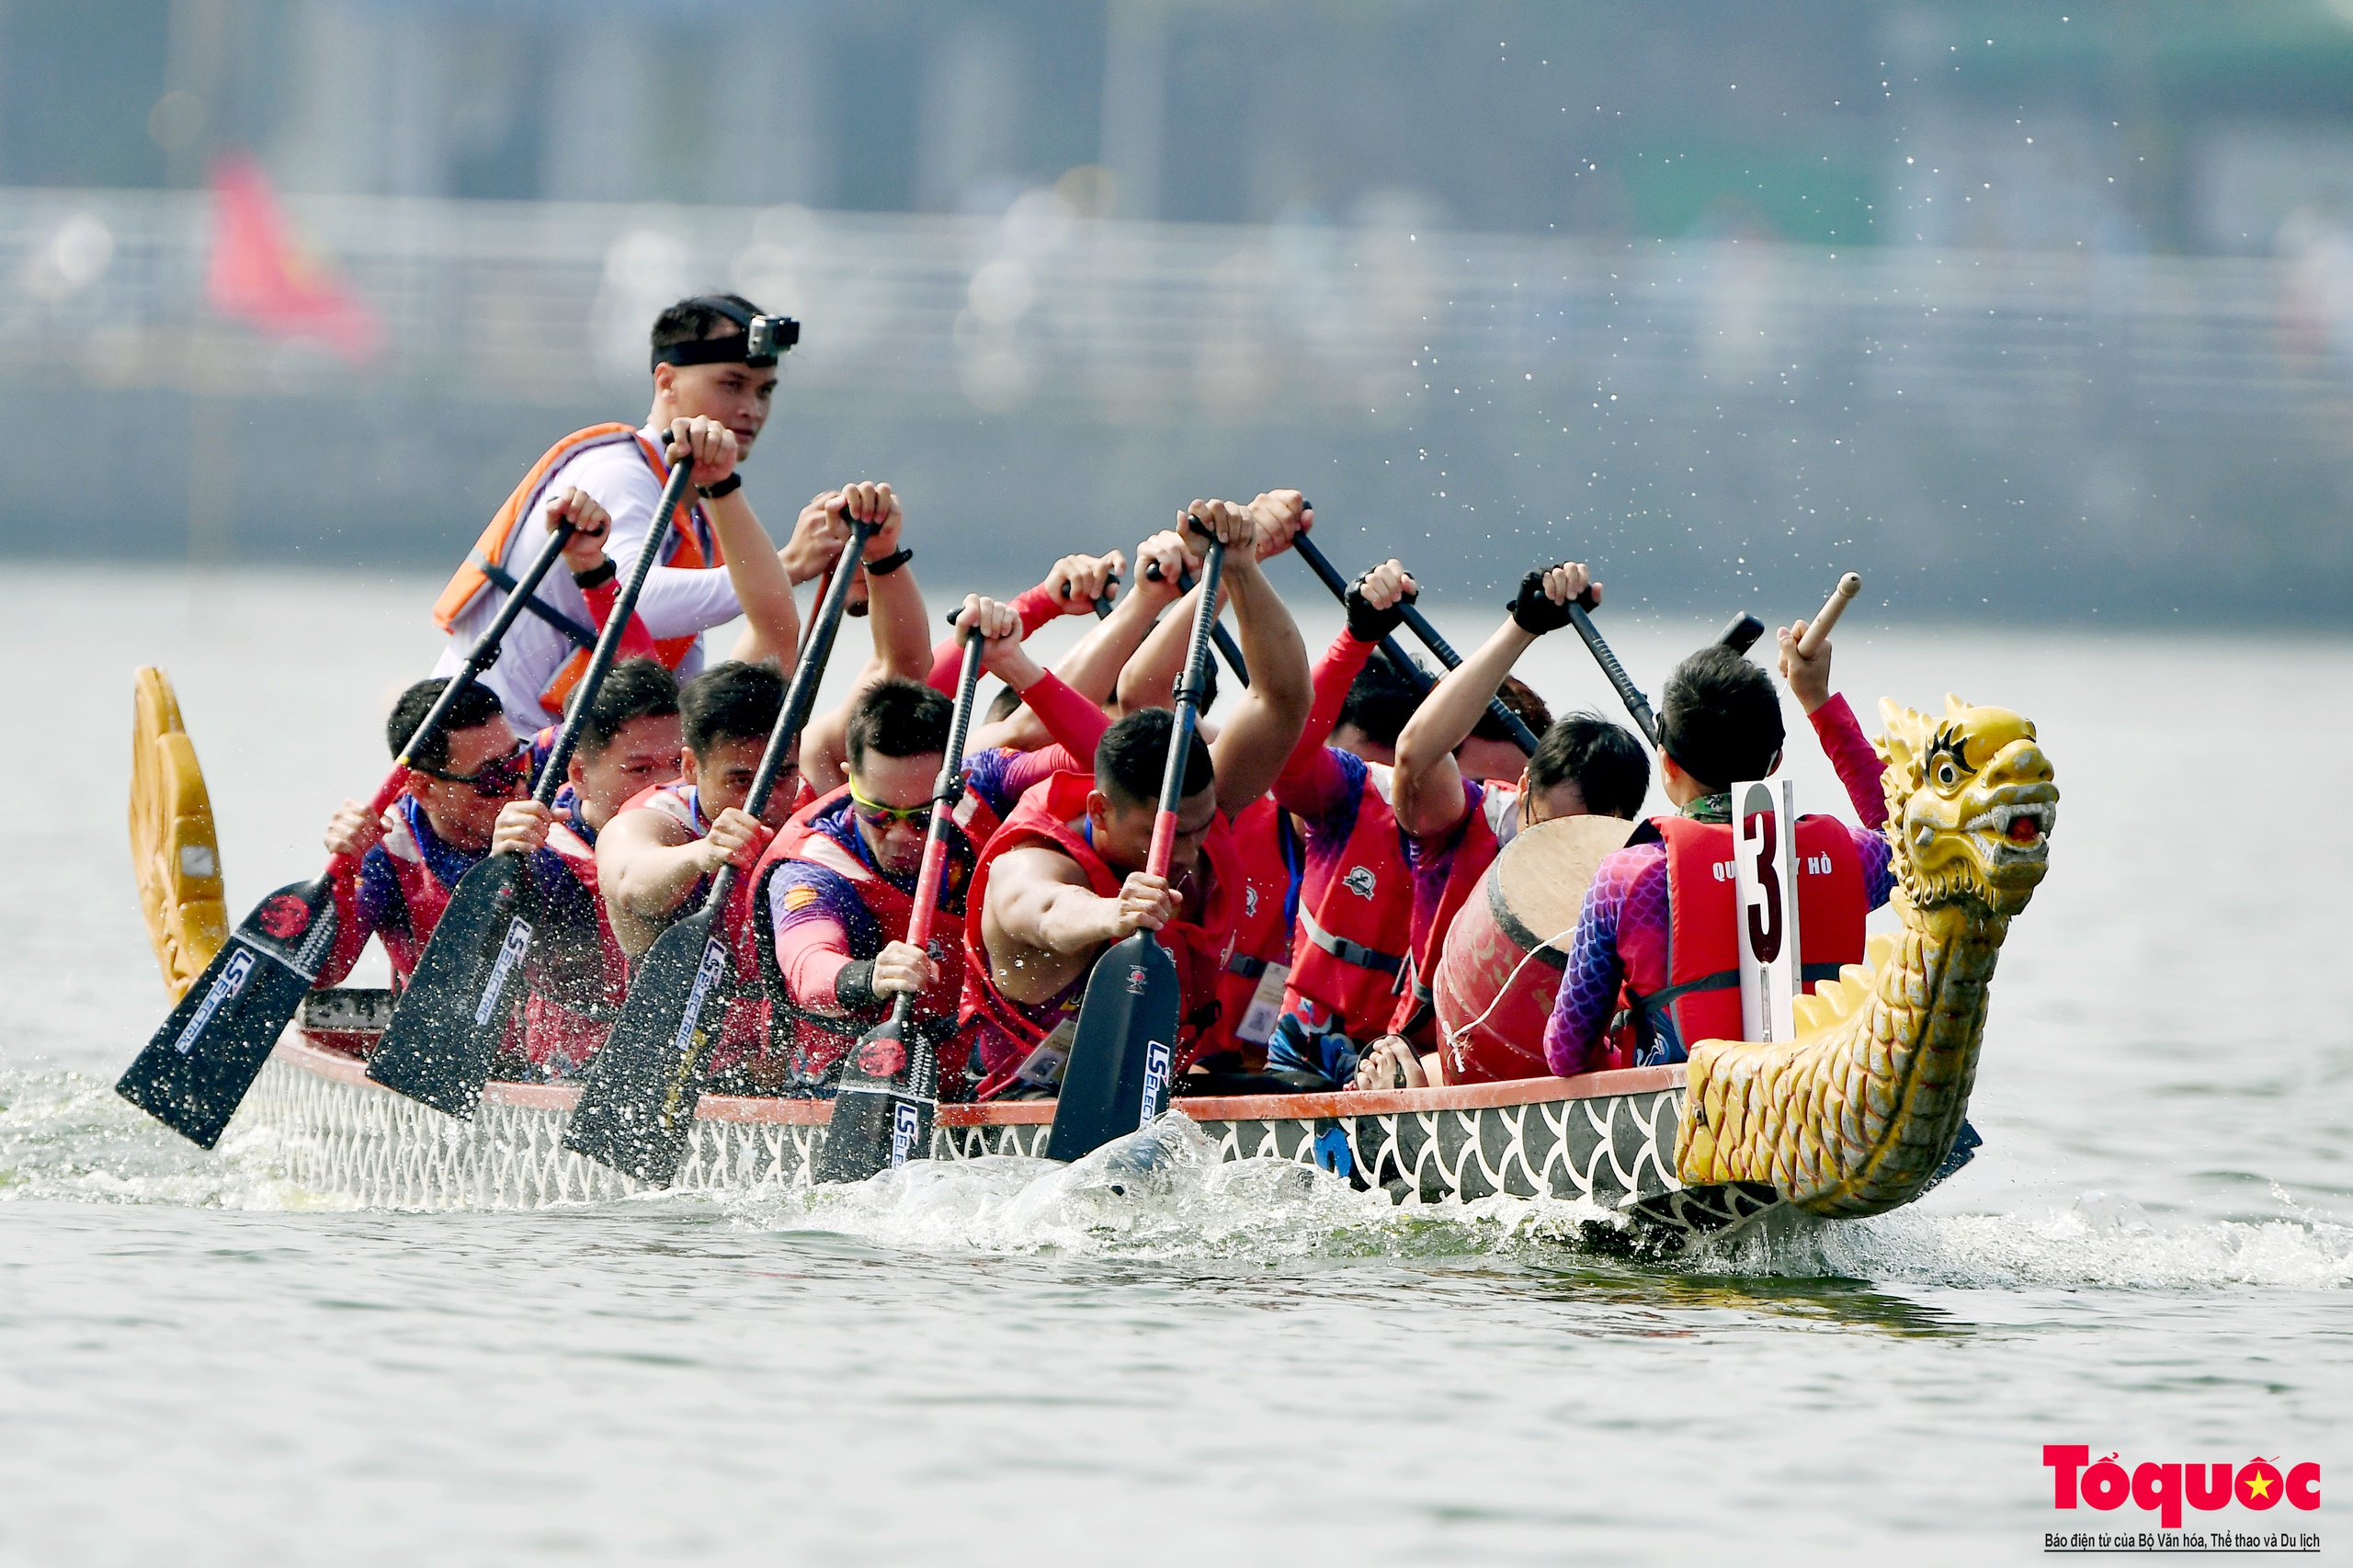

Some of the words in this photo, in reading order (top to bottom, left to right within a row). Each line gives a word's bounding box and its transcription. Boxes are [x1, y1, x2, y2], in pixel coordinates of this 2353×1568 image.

[1712, 859, 1735, 881] QU
[1807, 850, 1833, 875] HỒ
[1743, 782, 1782, 964] 3
